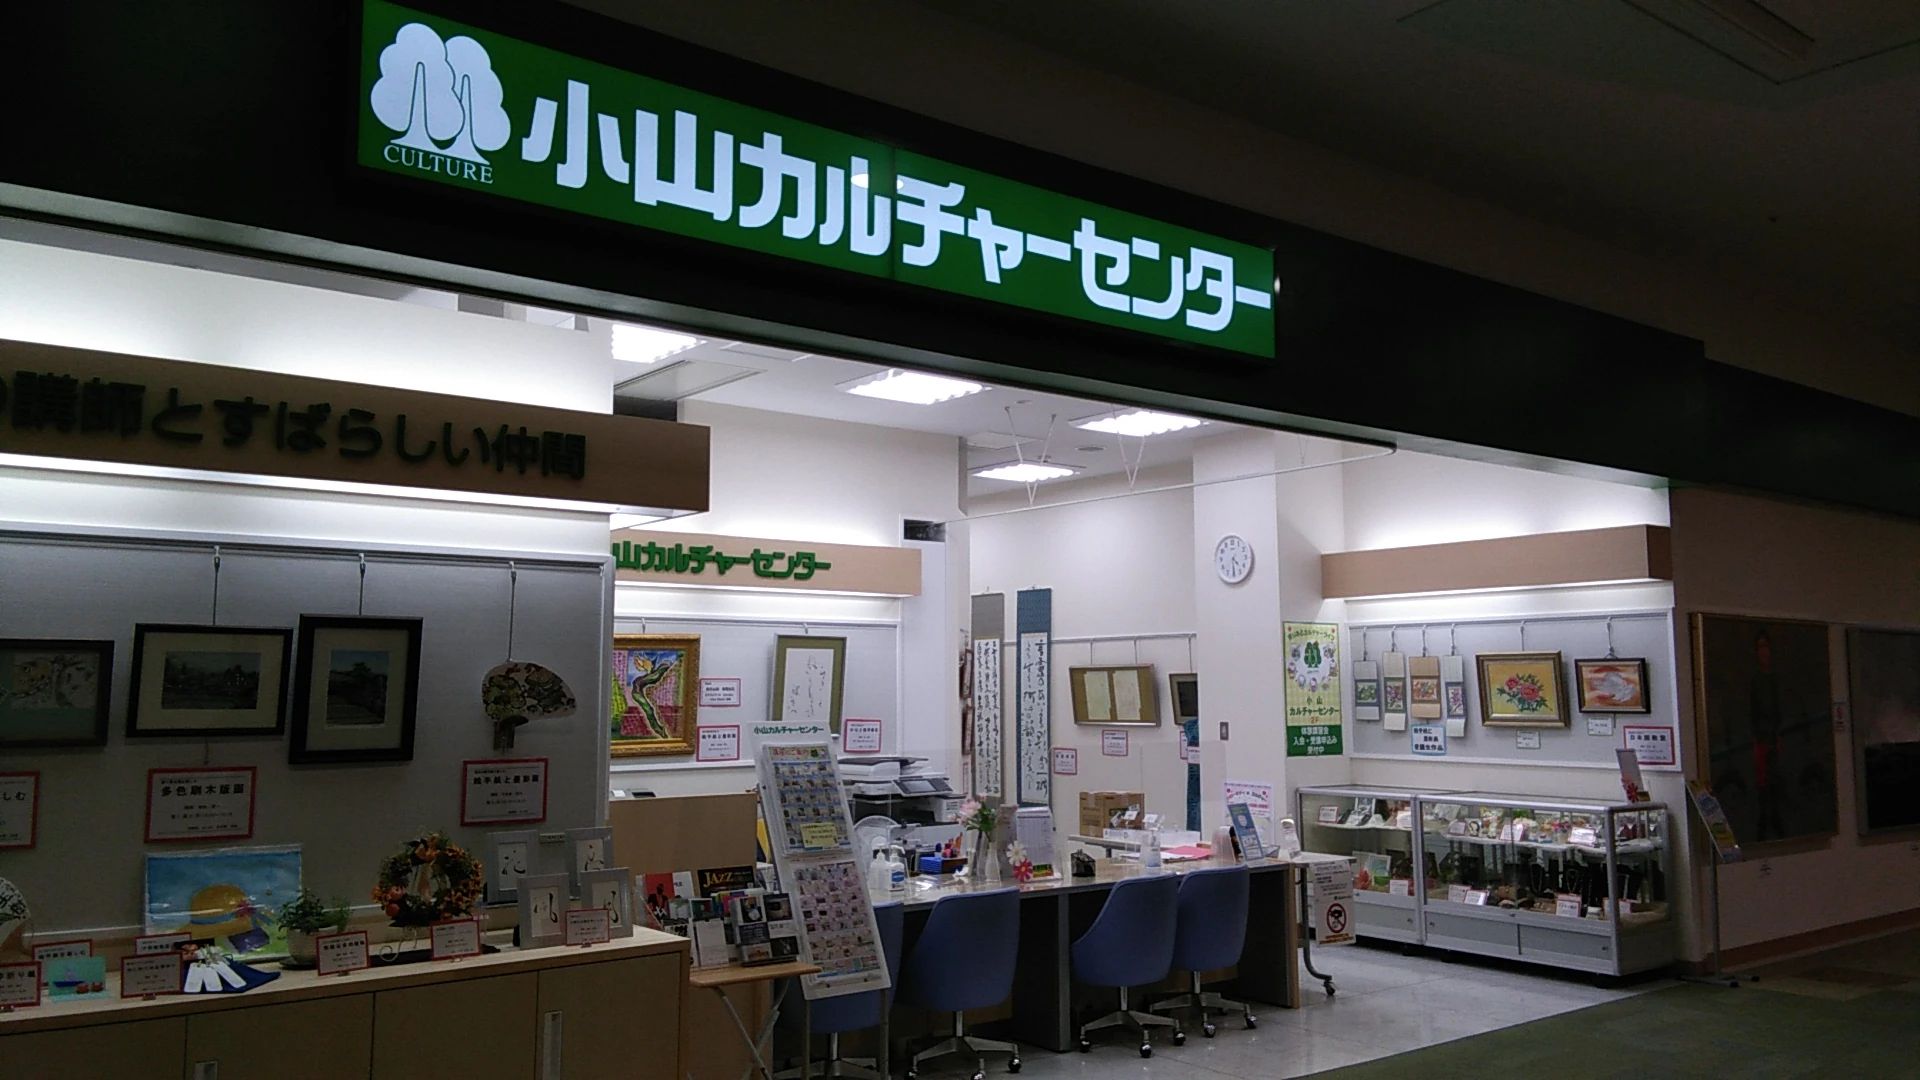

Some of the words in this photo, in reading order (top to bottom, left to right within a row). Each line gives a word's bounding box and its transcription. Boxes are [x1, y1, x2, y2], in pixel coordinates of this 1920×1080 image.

[383, 144, 494, 185] CULTURE
[522, 78, 1273, 333] 小山カルチャーセンター
[0, 370, 587, 481] 講師とすばらしい仲間
[753, 726, 824, 735] 小山カルチャーセンター
[1289, 707, 1340, 716] カルチャーセンター
